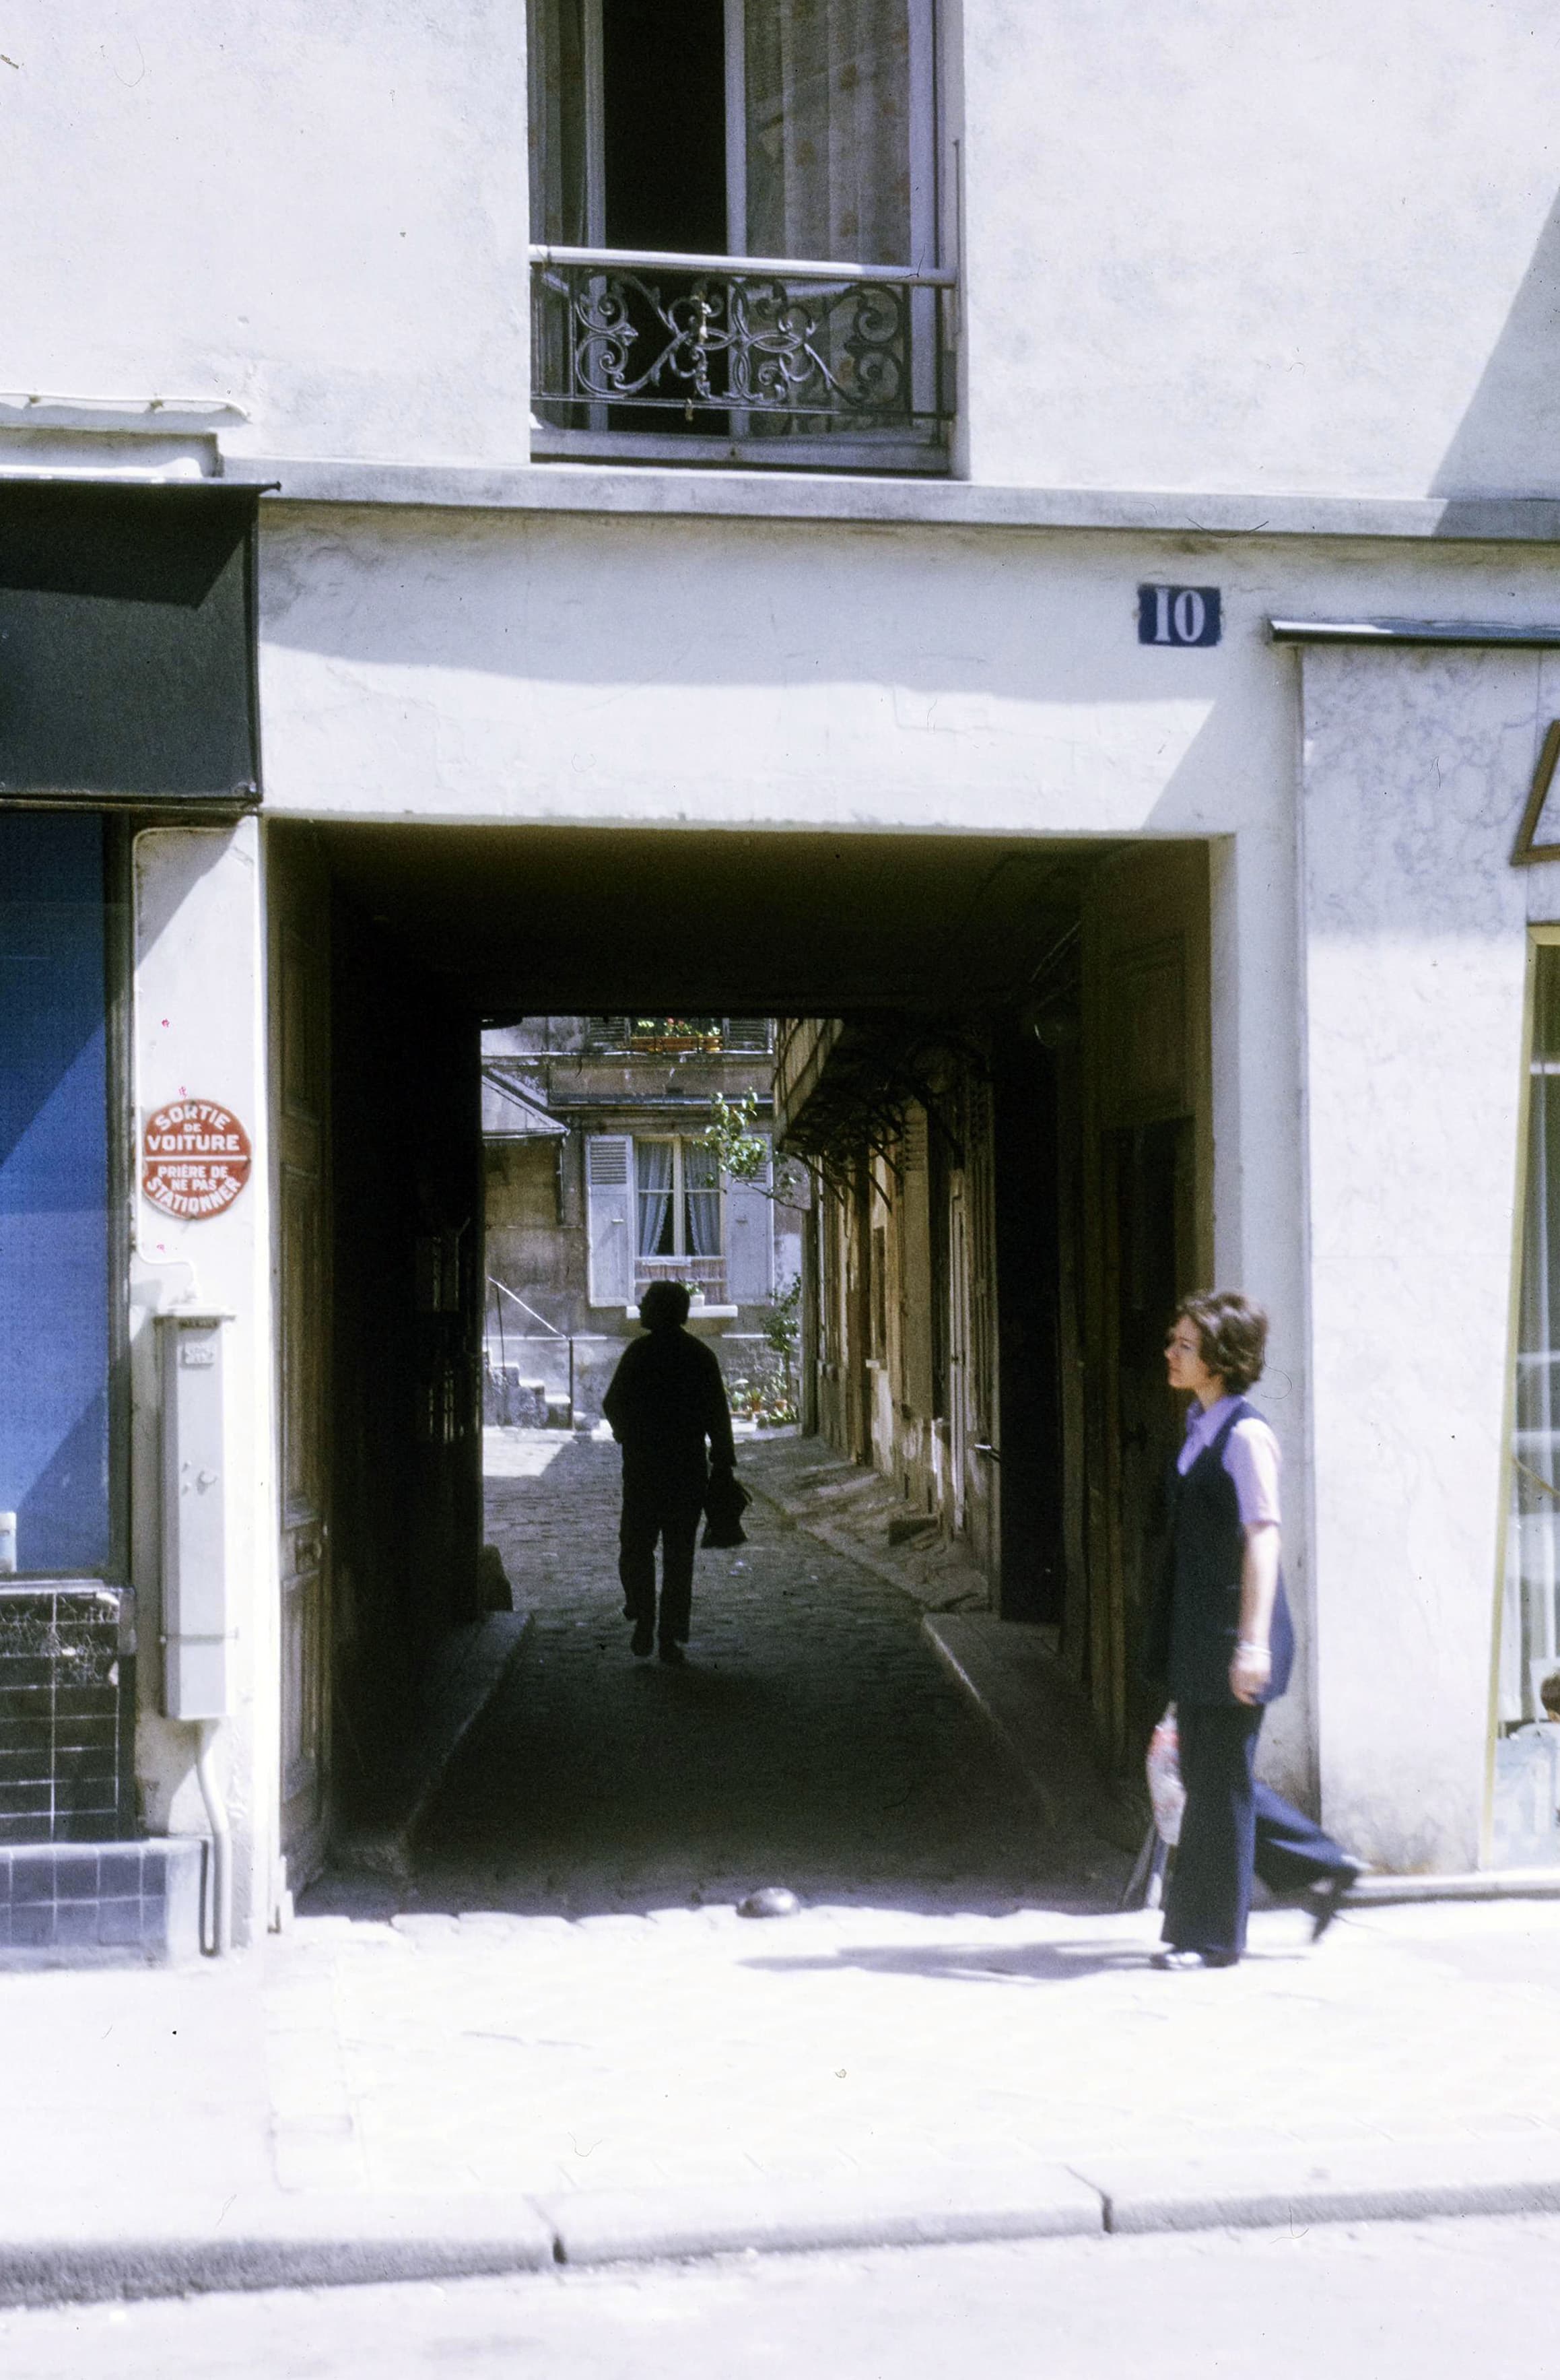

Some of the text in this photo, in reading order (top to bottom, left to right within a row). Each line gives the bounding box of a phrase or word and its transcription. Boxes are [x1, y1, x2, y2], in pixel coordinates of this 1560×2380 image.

[1155, 587, 1205, 642] 10
[154, 1104, 231, 1131] SORTIE
[183, 1123, 202, 1132] DE
[147, 1134, 240, 1151] VOITURE
[210, 1166, 228, 1178] DE
[171, 1179, 217, 1191] NE PAS
[147, 1177, 241, 1213] STATIONNER
